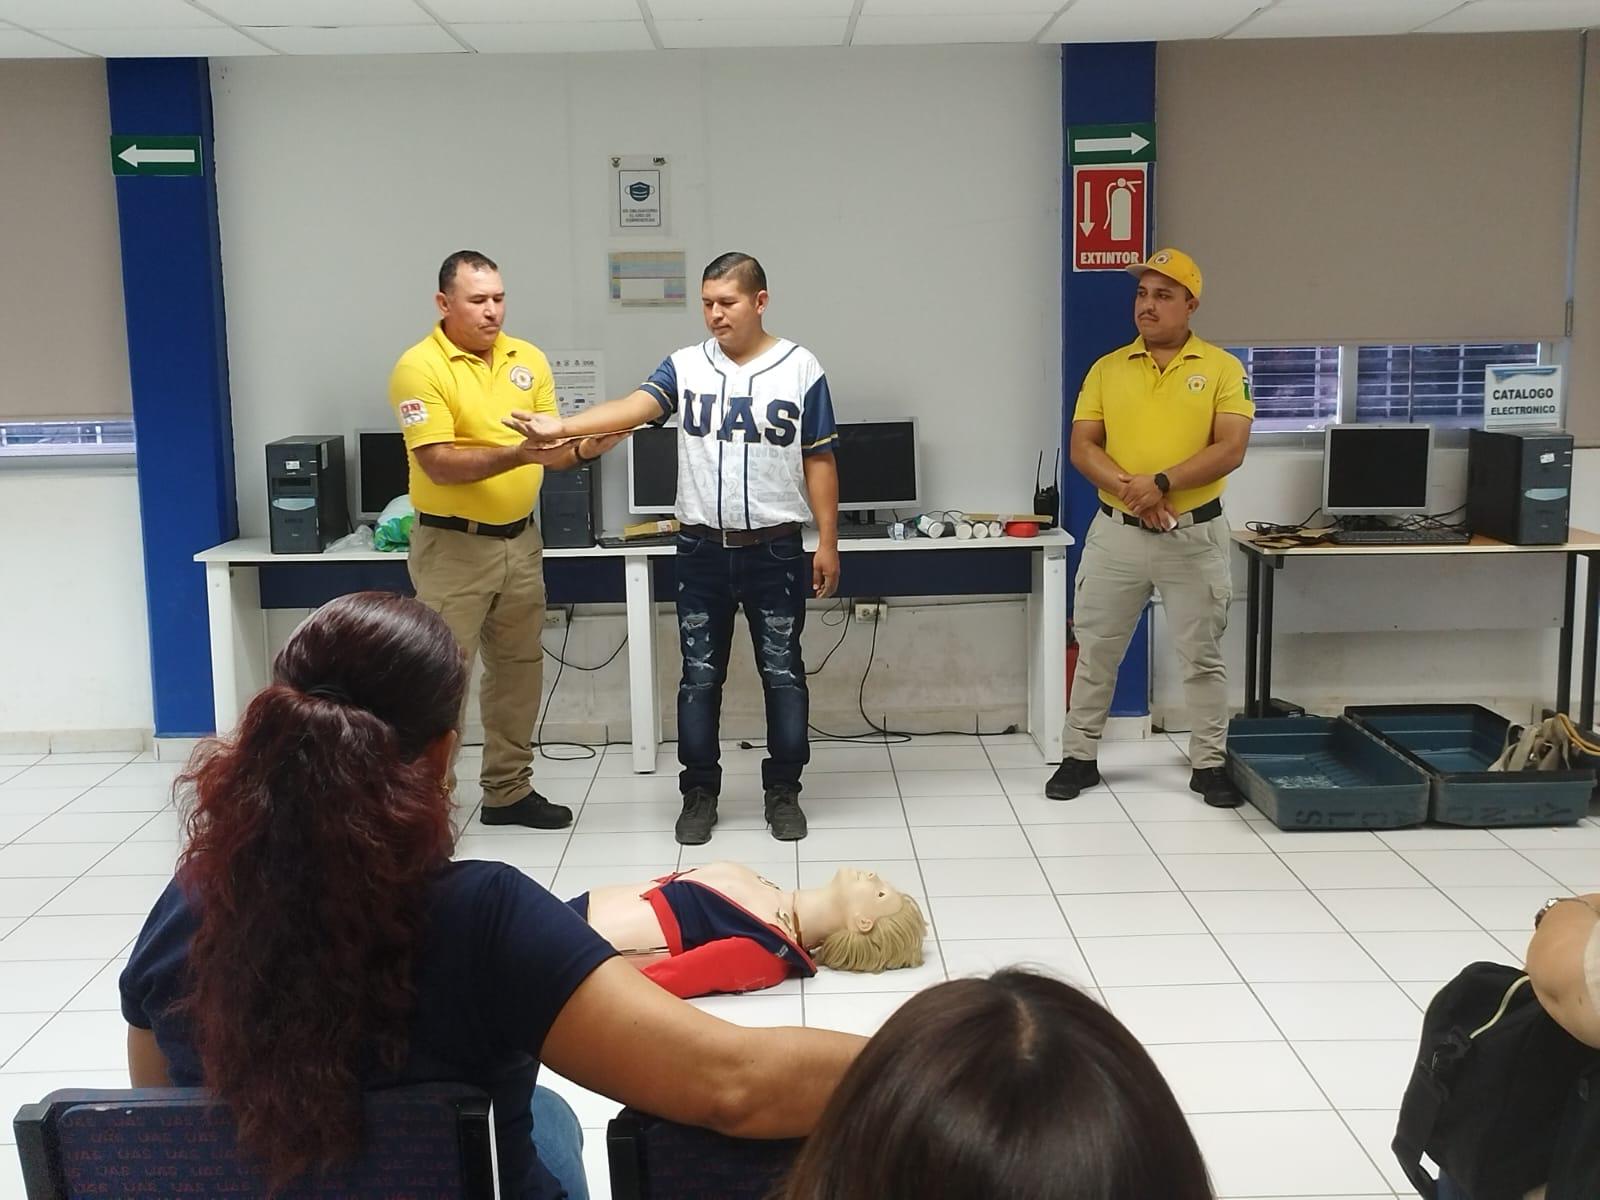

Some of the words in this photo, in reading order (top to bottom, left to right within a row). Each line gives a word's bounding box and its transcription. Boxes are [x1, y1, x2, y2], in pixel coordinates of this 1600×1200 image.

[1080, 251, 1140, 265] EXTINTOR
[1492, 388, 1554, 400] CATALOGO
[1491, 405, 1556, 415] ELECTRONICO
[683, 388, 800, 448] UAS
